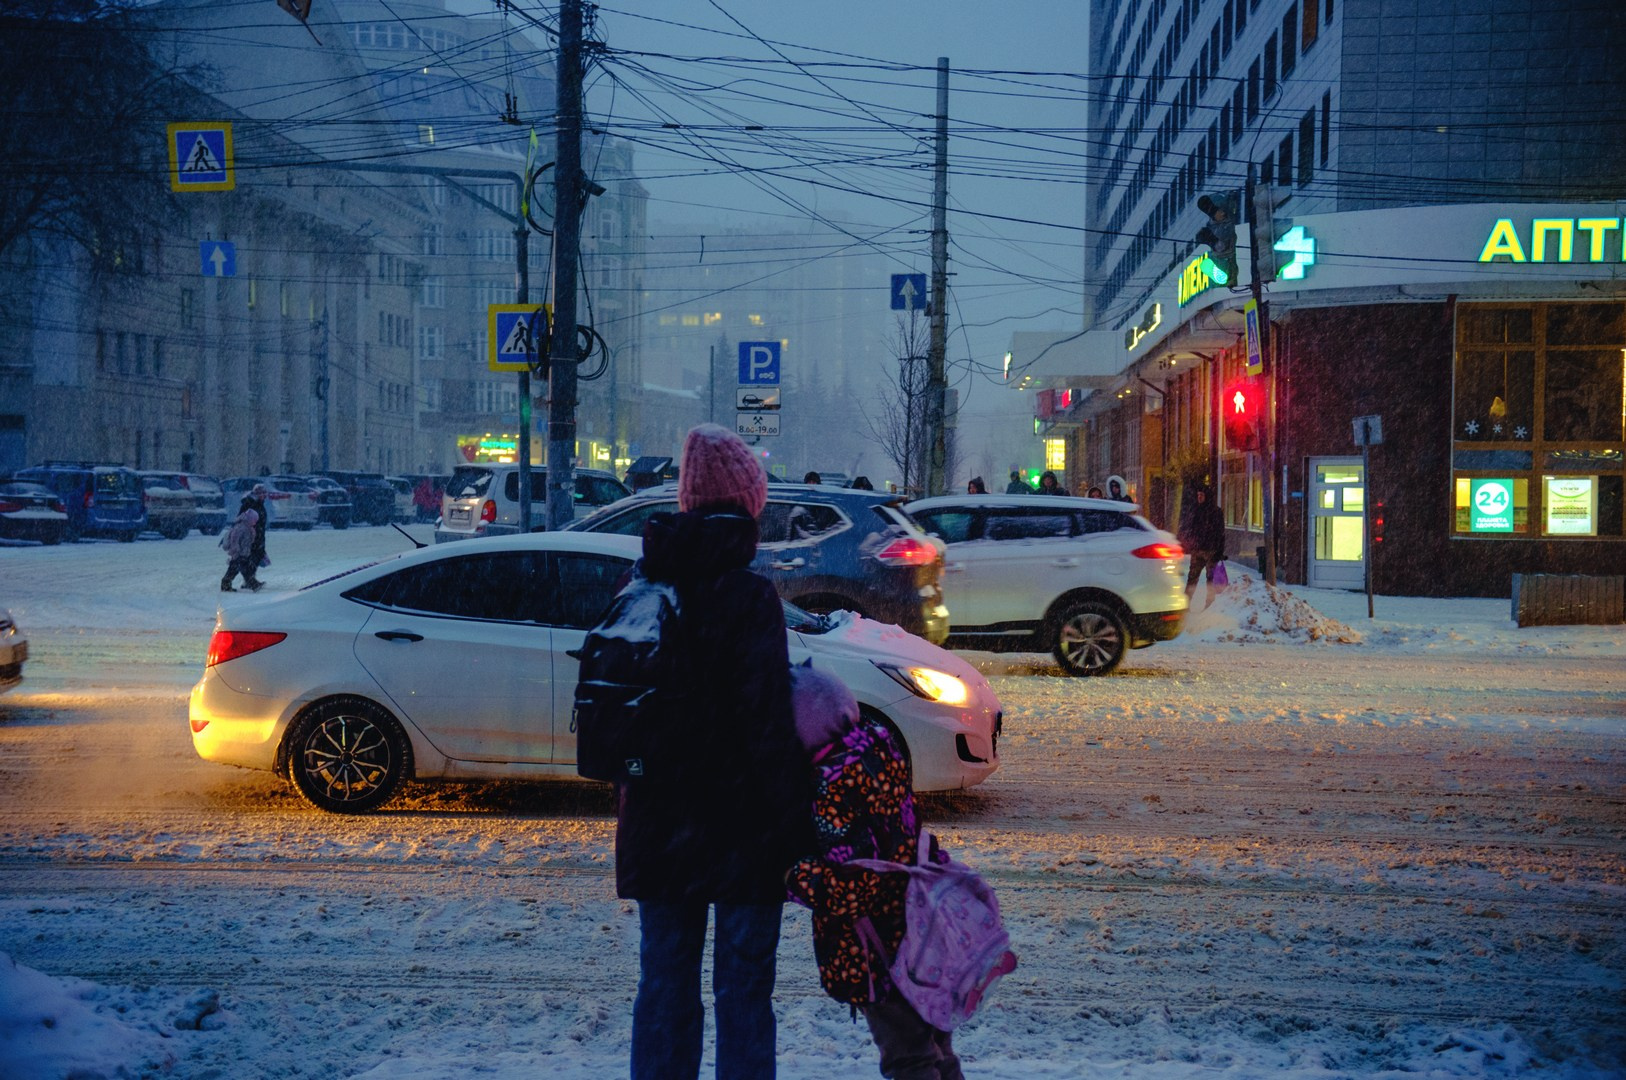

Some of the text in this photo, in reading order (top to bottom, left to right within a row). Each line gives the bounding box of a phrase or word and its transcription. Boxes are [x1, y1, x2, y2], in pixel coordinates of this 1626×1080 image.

[1478, 217, 1626, 262] АПТ
[749, 346, 773, 380] P
[1479, 491, 1507, 507] 24
